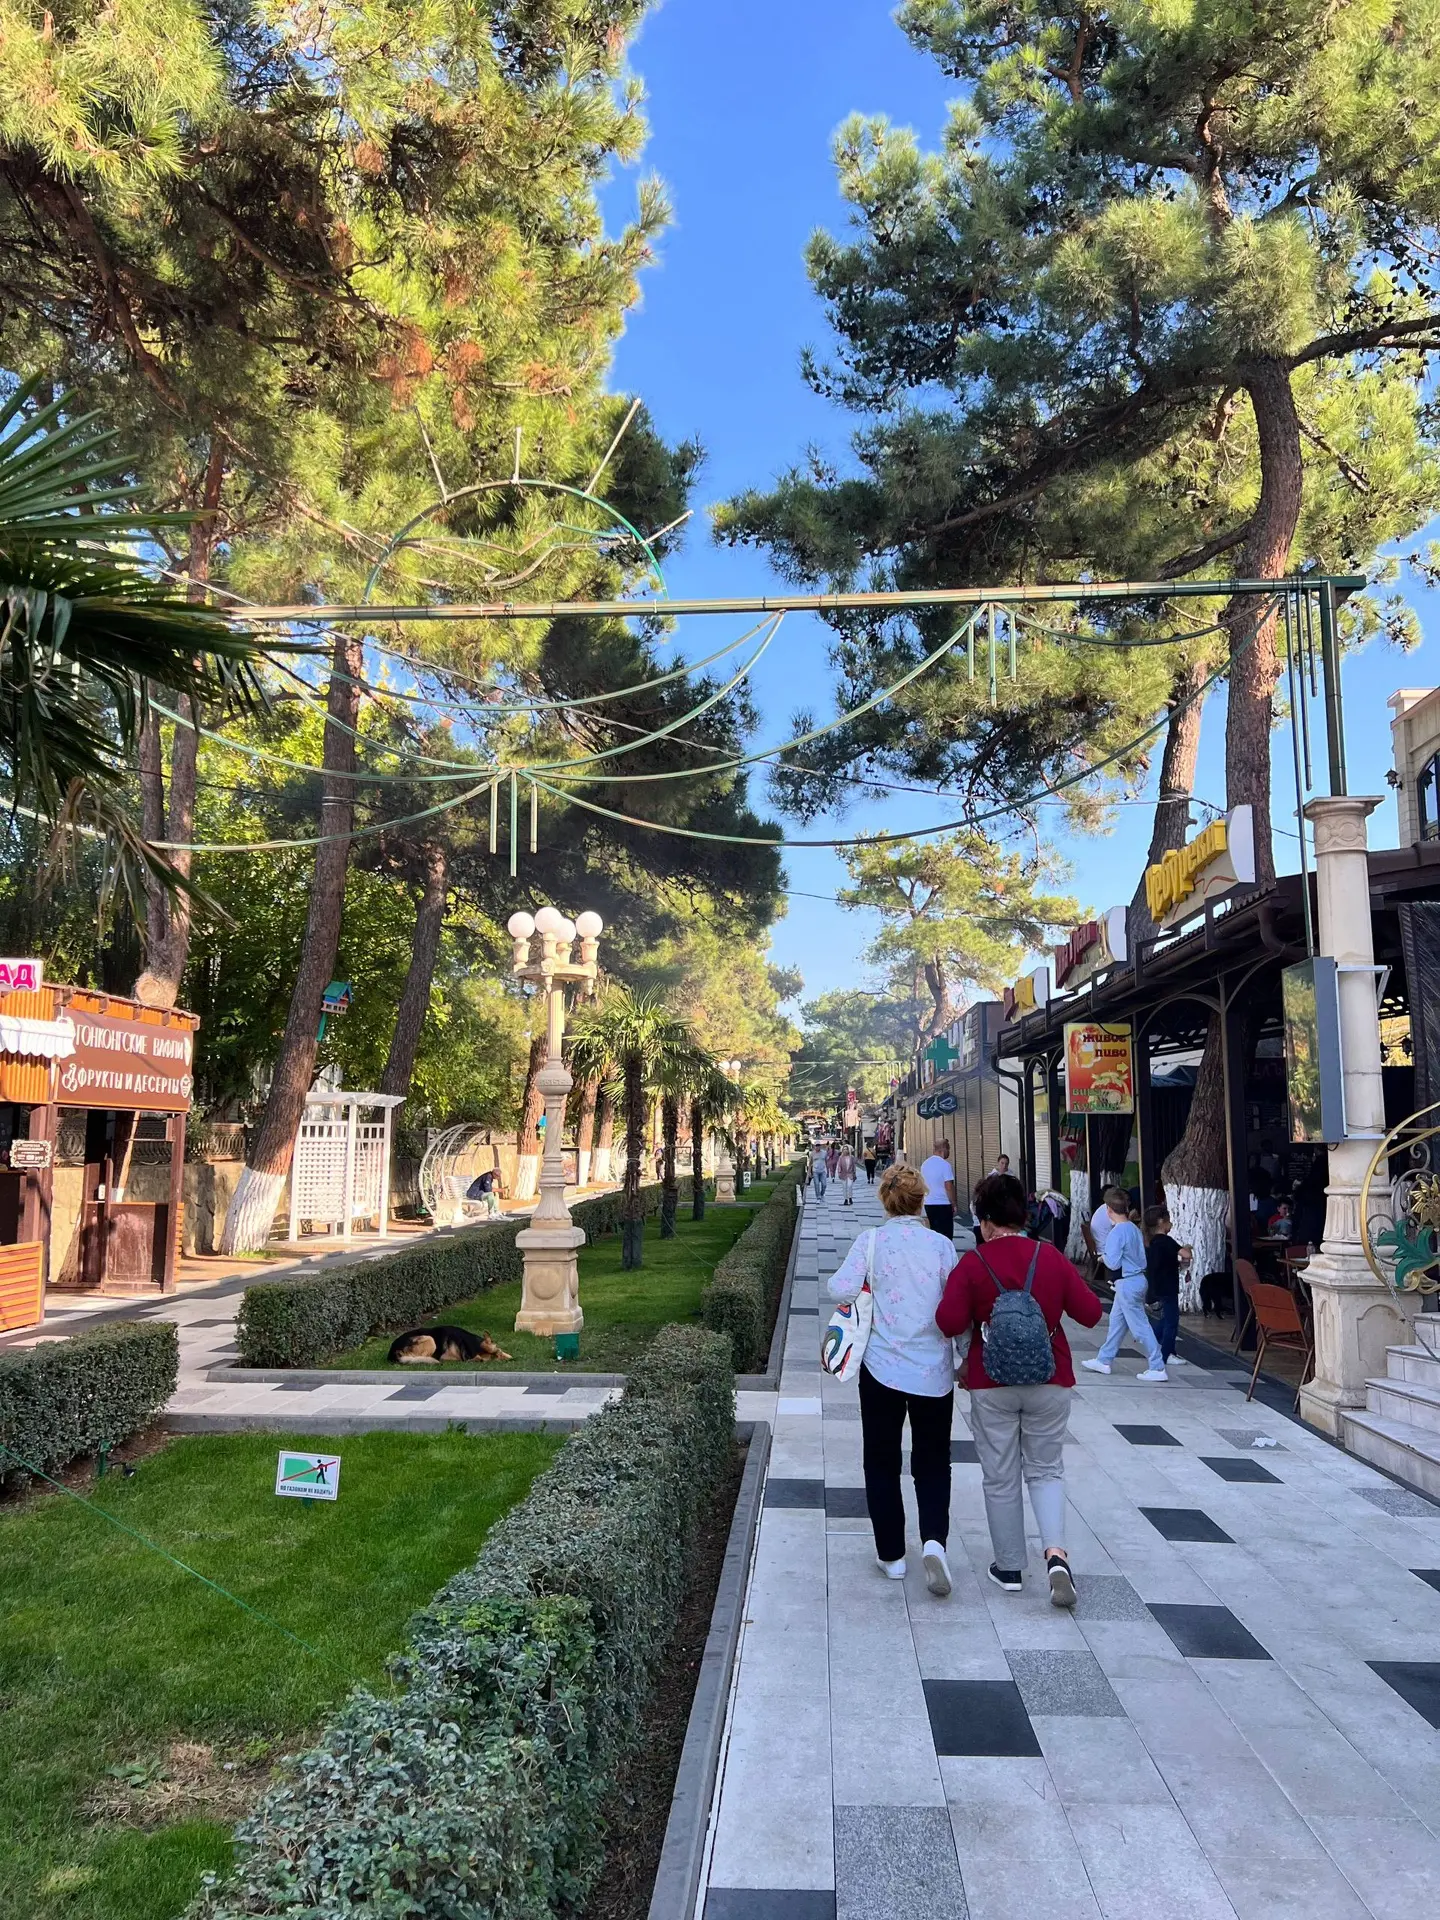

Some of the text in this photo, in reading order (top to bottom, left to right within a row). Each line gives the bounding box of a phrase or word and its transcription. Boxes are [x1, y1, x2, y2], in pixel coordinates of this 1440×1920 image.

[76, 1024, 183, 1060] ГОНКОНГСКИЕ ВАФЛИ
[1095, 1047, 1127, 1057] пиво
[78, 1067, 179, 1094] ФРУКТЫ И ДЕСЕРТЫ
